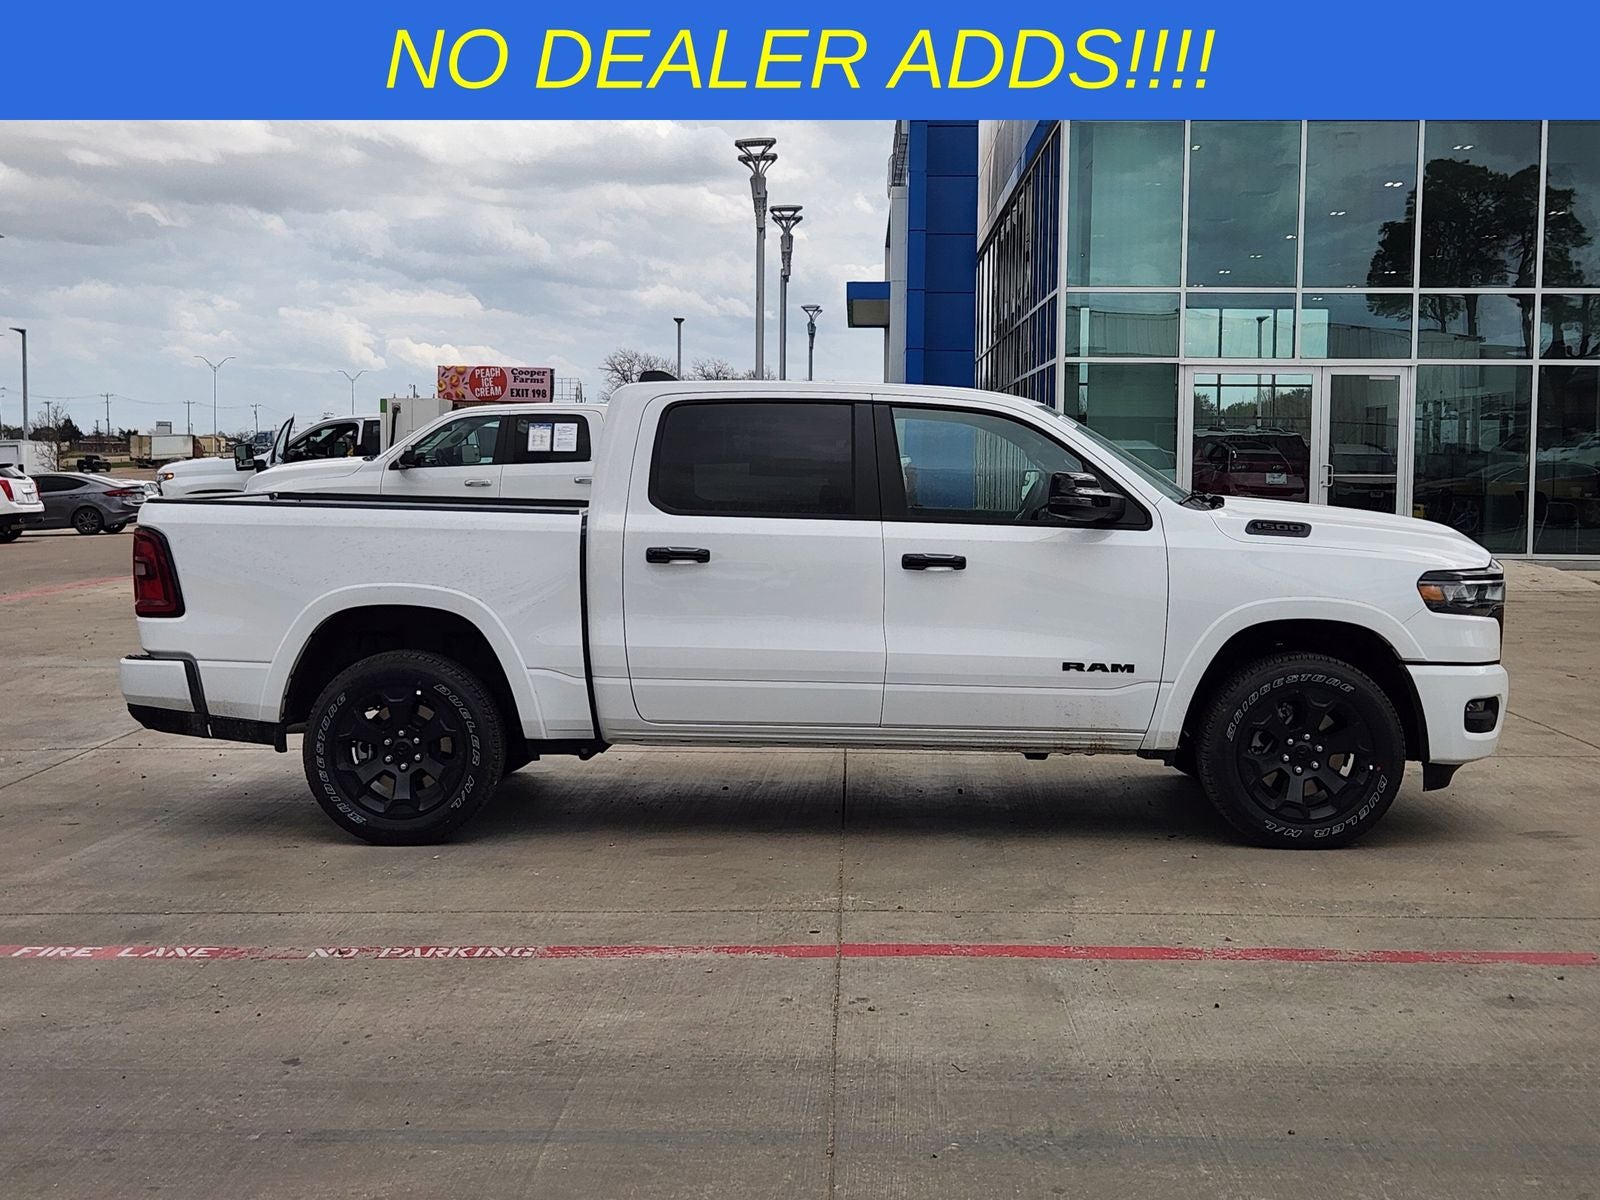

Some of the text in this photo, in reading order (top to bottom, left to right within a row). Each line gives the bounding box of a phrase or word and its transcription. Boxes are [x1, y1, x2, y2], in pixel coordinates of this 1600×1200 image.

[475, 368, 501, 379] PEACH
[511, 368, 548, 378] Cooper
[481, 378, 494, 387] ICE
[513, 376, 545, 384] Farms
[474, 386, 502, 397] CREAM
[510, 388, 547, 398] EXIT 198
[1256, 522, 1302, 531] 1500
[1062, 662, 1135, 673] RAM
[1226, 673, 1355, 742] BRIDGESTONE
[316, 692, 368, 824] BRIDGESTONE
[12, 946, 220, 958] FIRE LANE
[307, 946, 537, 959] NO PARKING
